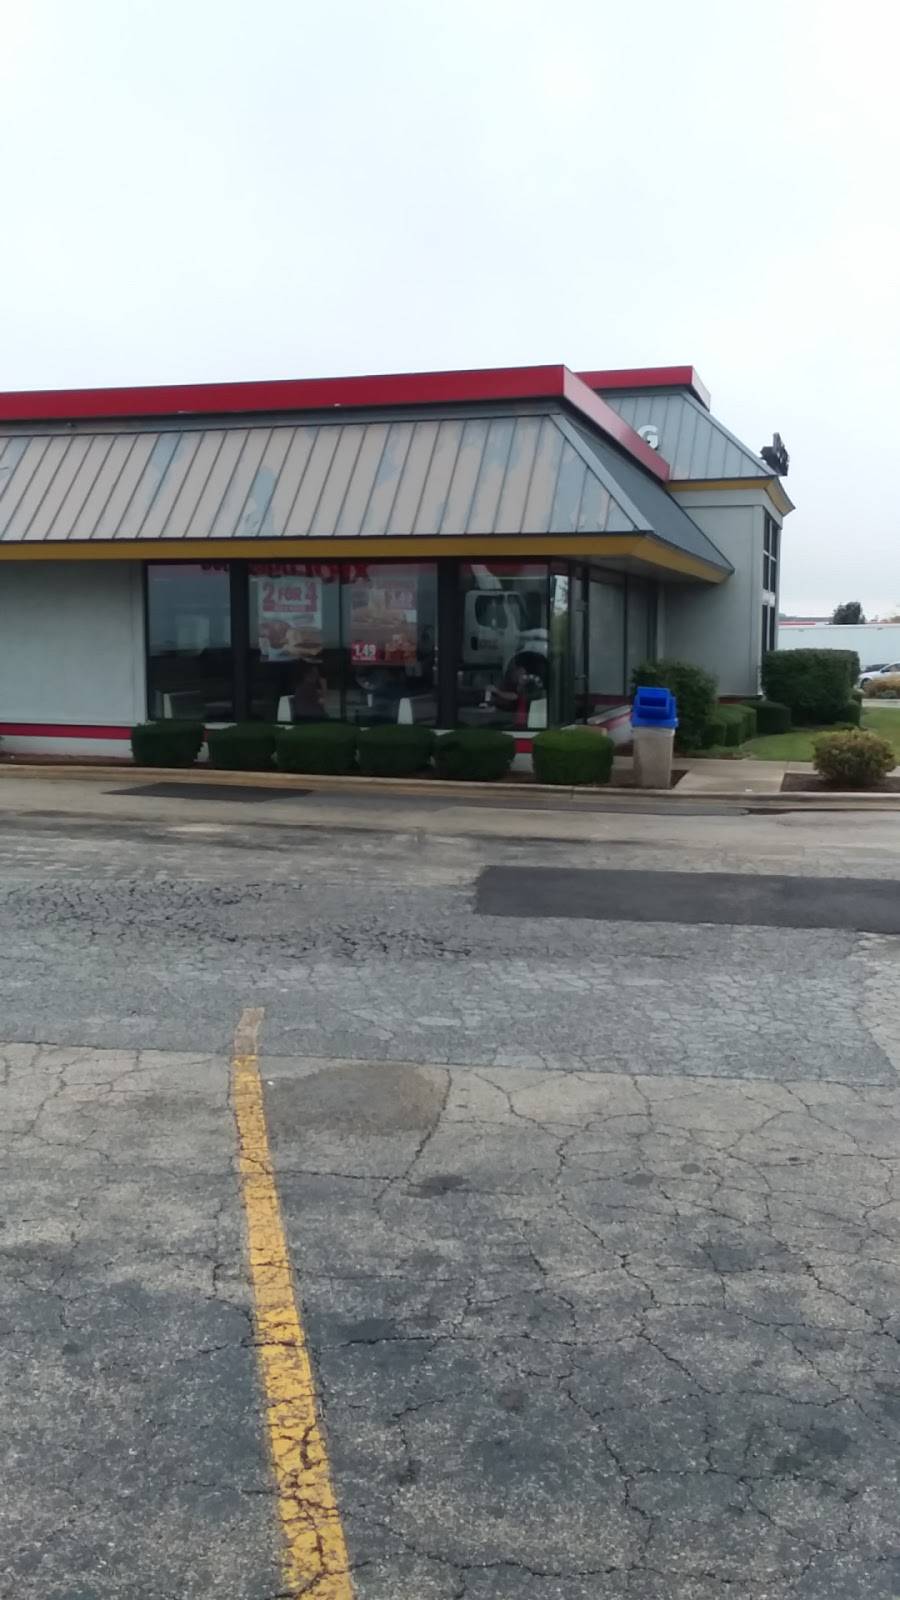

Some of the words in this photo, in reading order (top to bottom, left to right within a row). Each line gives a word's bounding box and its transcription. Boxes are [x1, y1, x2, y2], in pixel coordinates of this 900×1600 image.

[637, 424, 660, 450] G
[263, 581, 275, 605] 2
[278, 586, 301, 601] FOR
